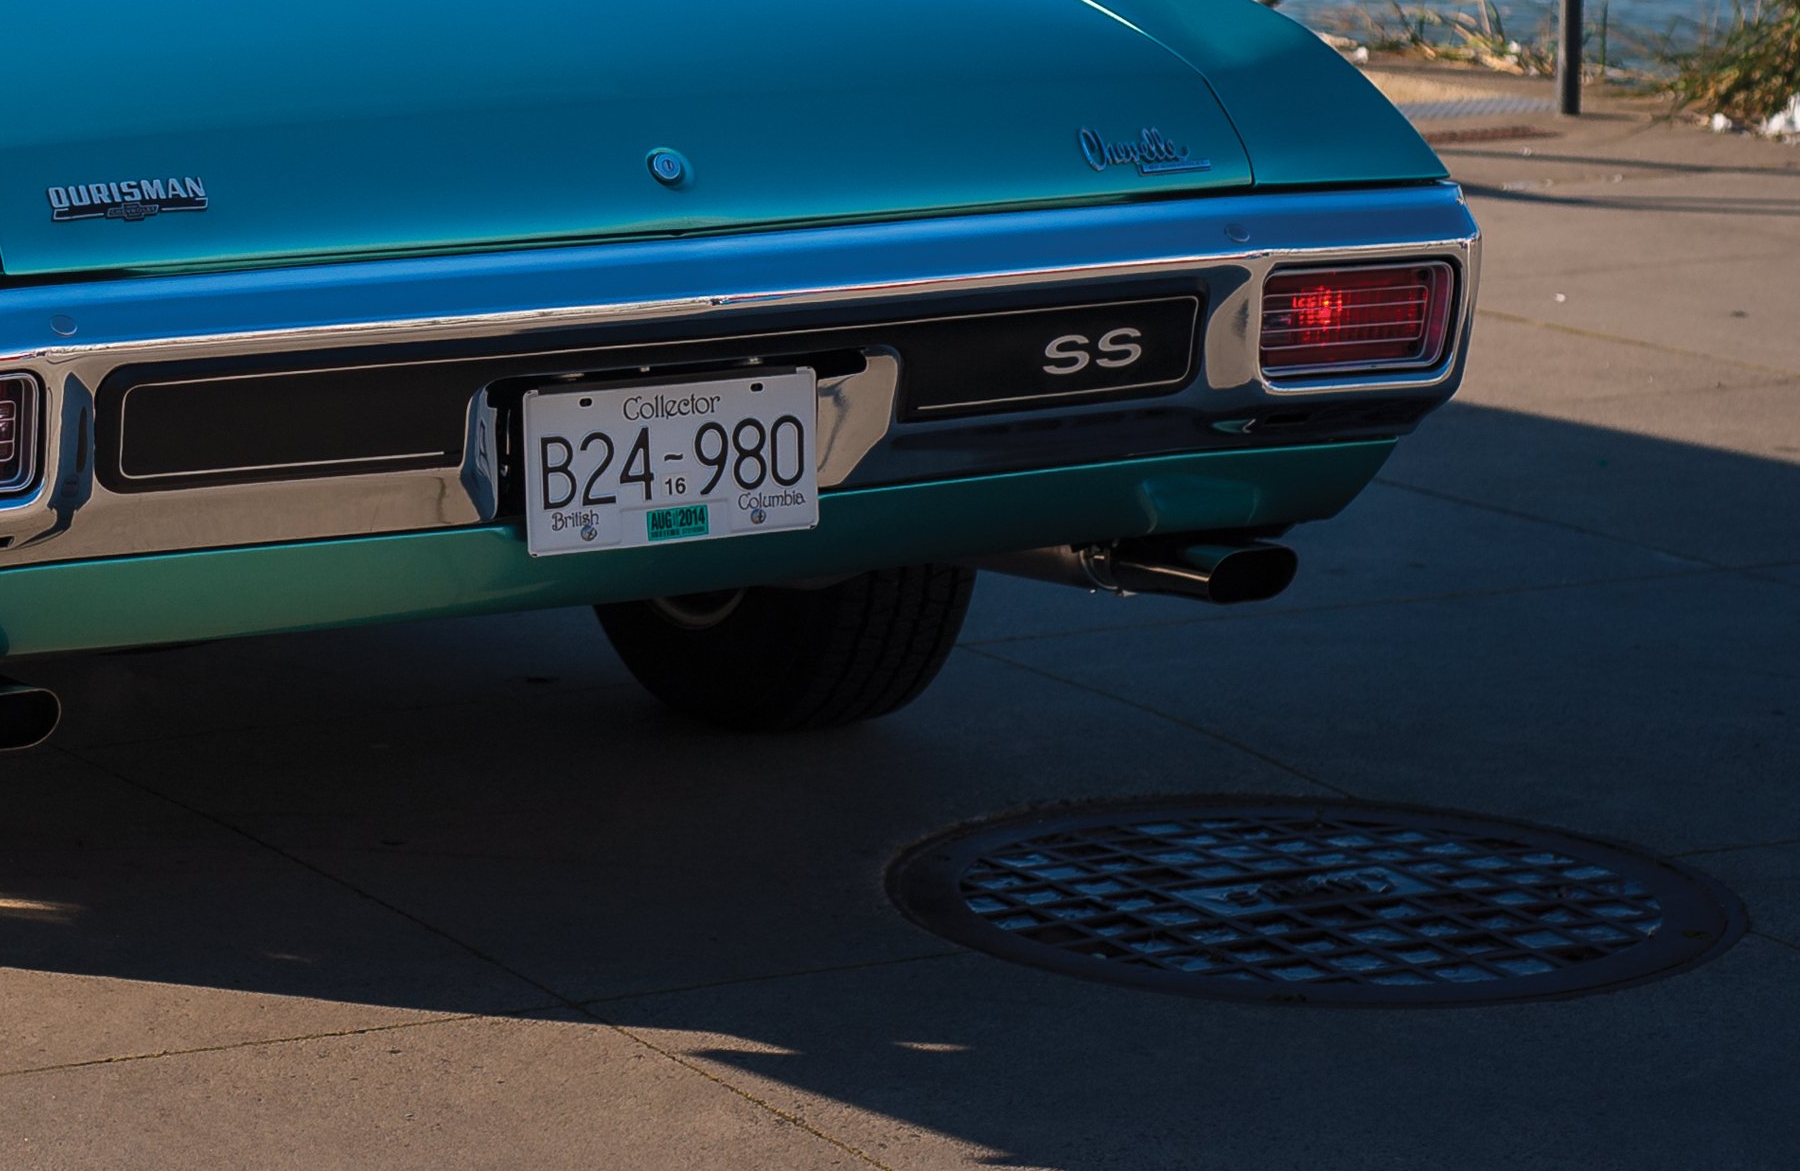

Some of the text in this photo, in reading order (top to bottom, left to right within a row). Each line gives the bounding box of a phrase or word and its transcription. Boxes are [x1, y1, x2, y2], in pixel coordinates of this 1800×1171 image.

[1079, 127, 1190, 172] Chevelle
[48, 176, 207, 208] OURISMAN
[1042, 327, 1142, 375] SS
[622, 393, 721, 421] Collector
[540, 415, 804, 510] B24-980
[664, 477, 686, 495] 16
[551, 489, 806, 531] British Columbia
[651, 507, 706, 530] AUG 2014
